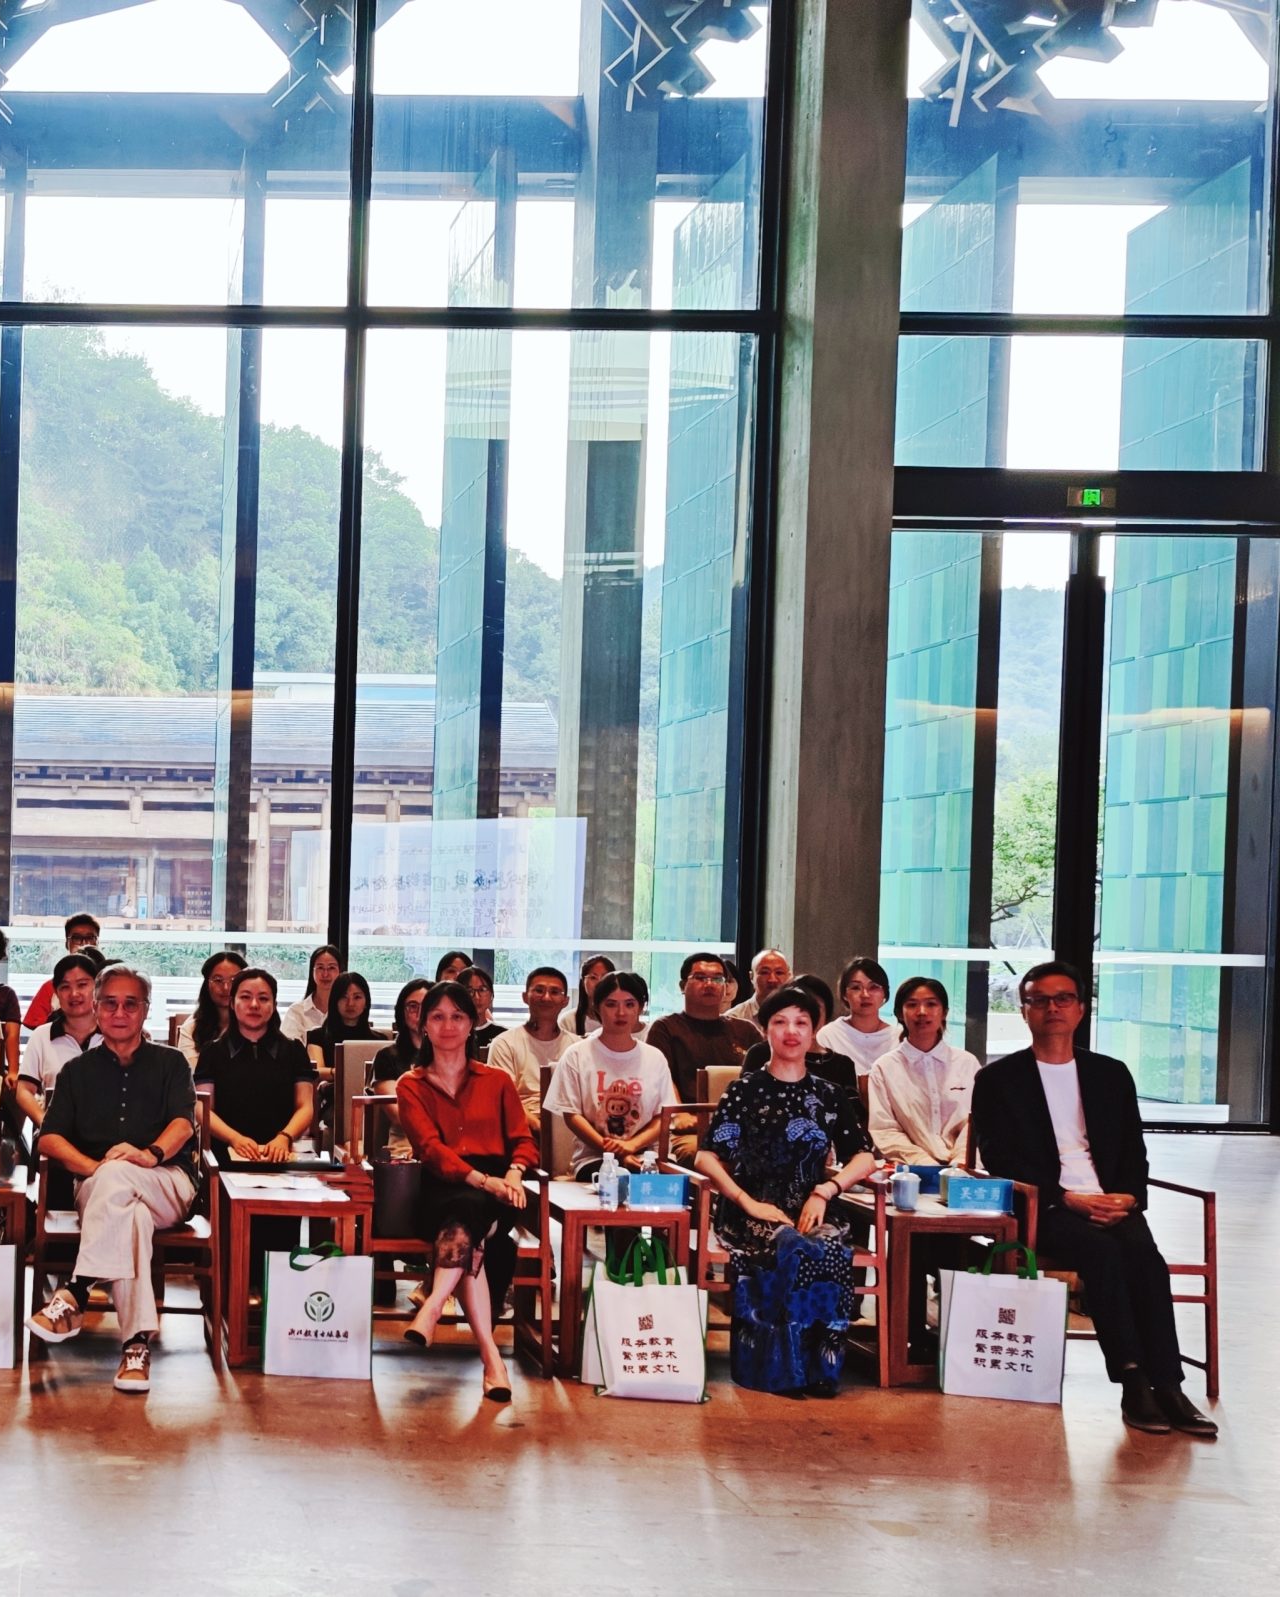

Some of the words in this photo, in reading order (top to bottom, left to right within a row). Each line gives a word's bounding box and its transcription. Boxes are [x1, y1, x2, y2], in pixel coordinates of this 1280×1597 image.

[621, 1337, 674, 1347] 服务教育
[976, 1328, 1035, 1344] 服务教育
[622, 1350, 677, 1361] 繁荣学术
[975, 1342, 1034, 1359] 繁荣学术
[623, 1364, 680, 1374] 积累文化
[973, 1357, 1033, 1373] 积累文化
